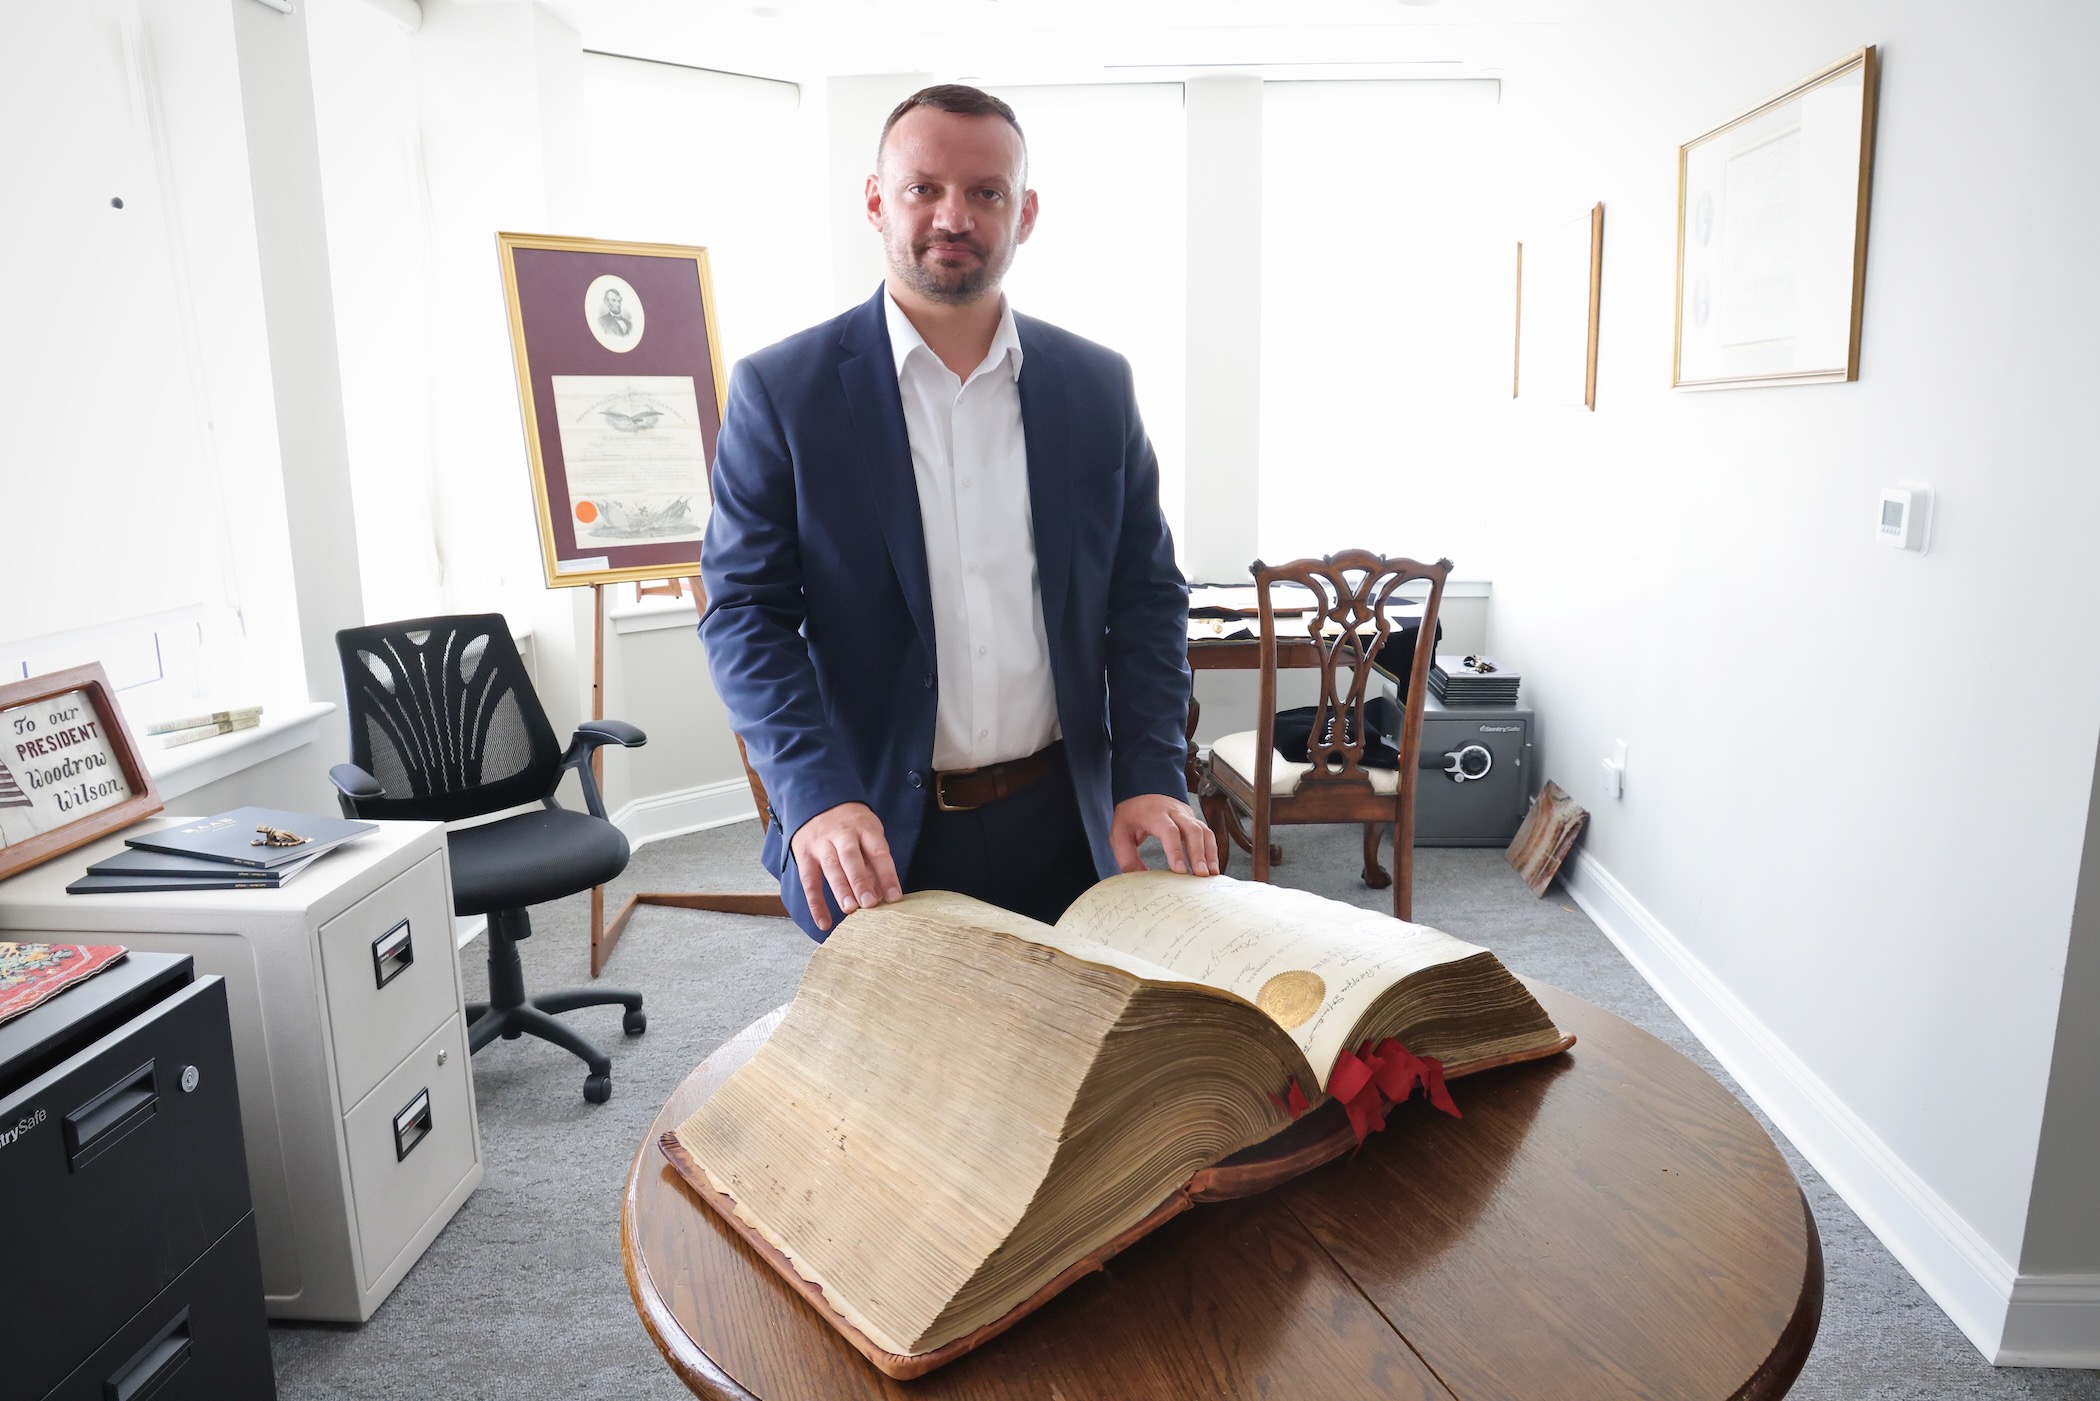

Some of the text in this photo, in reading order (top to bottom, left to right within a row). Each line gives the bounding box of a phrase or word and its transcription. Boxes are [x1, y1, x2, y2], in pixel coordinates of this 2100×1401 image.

[13, 707, 79, 735] To our
[15, 722, 98, 761] PRESIDENT
[25, 752, 107, 789] Woodrow
[53, 779, 124, 812] Wilson.
[0, 1109, 47, 1149] trySafe
